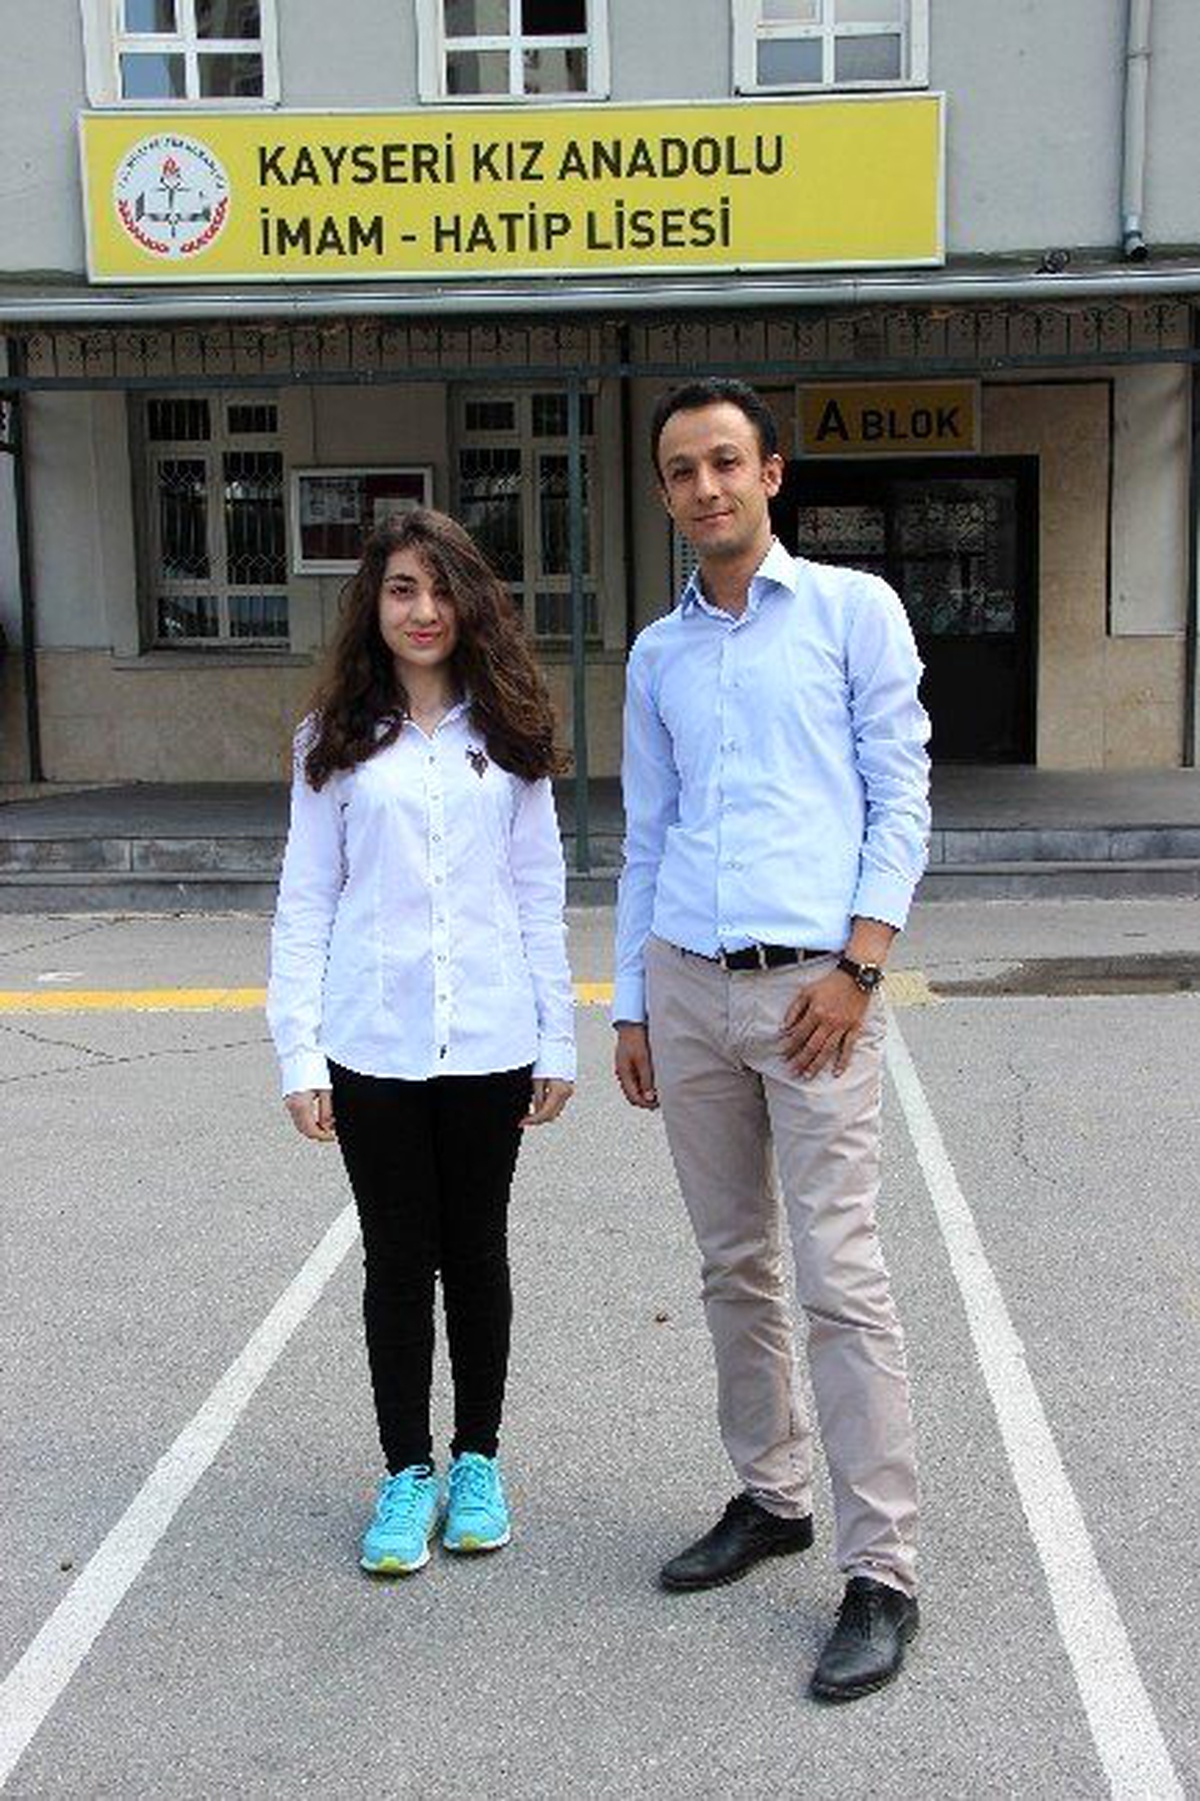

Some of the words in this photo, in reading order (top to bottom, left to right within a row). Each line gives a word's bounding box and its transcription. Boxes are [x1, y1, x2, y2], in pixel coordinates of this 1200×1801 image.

[258, 132, 455, 188] KAYSERİ
[472, 141, 544, 183] KIZ
[557, 134, 784, 181] ANADOLU
[259, 206, 384, 257] İMAM
[434, 201, 572, 253] HATİP
[586, 196, 731, 251] LİSESİ
[815, 399, 850, 442] A
[861, 407, 962, 441] BLOK
